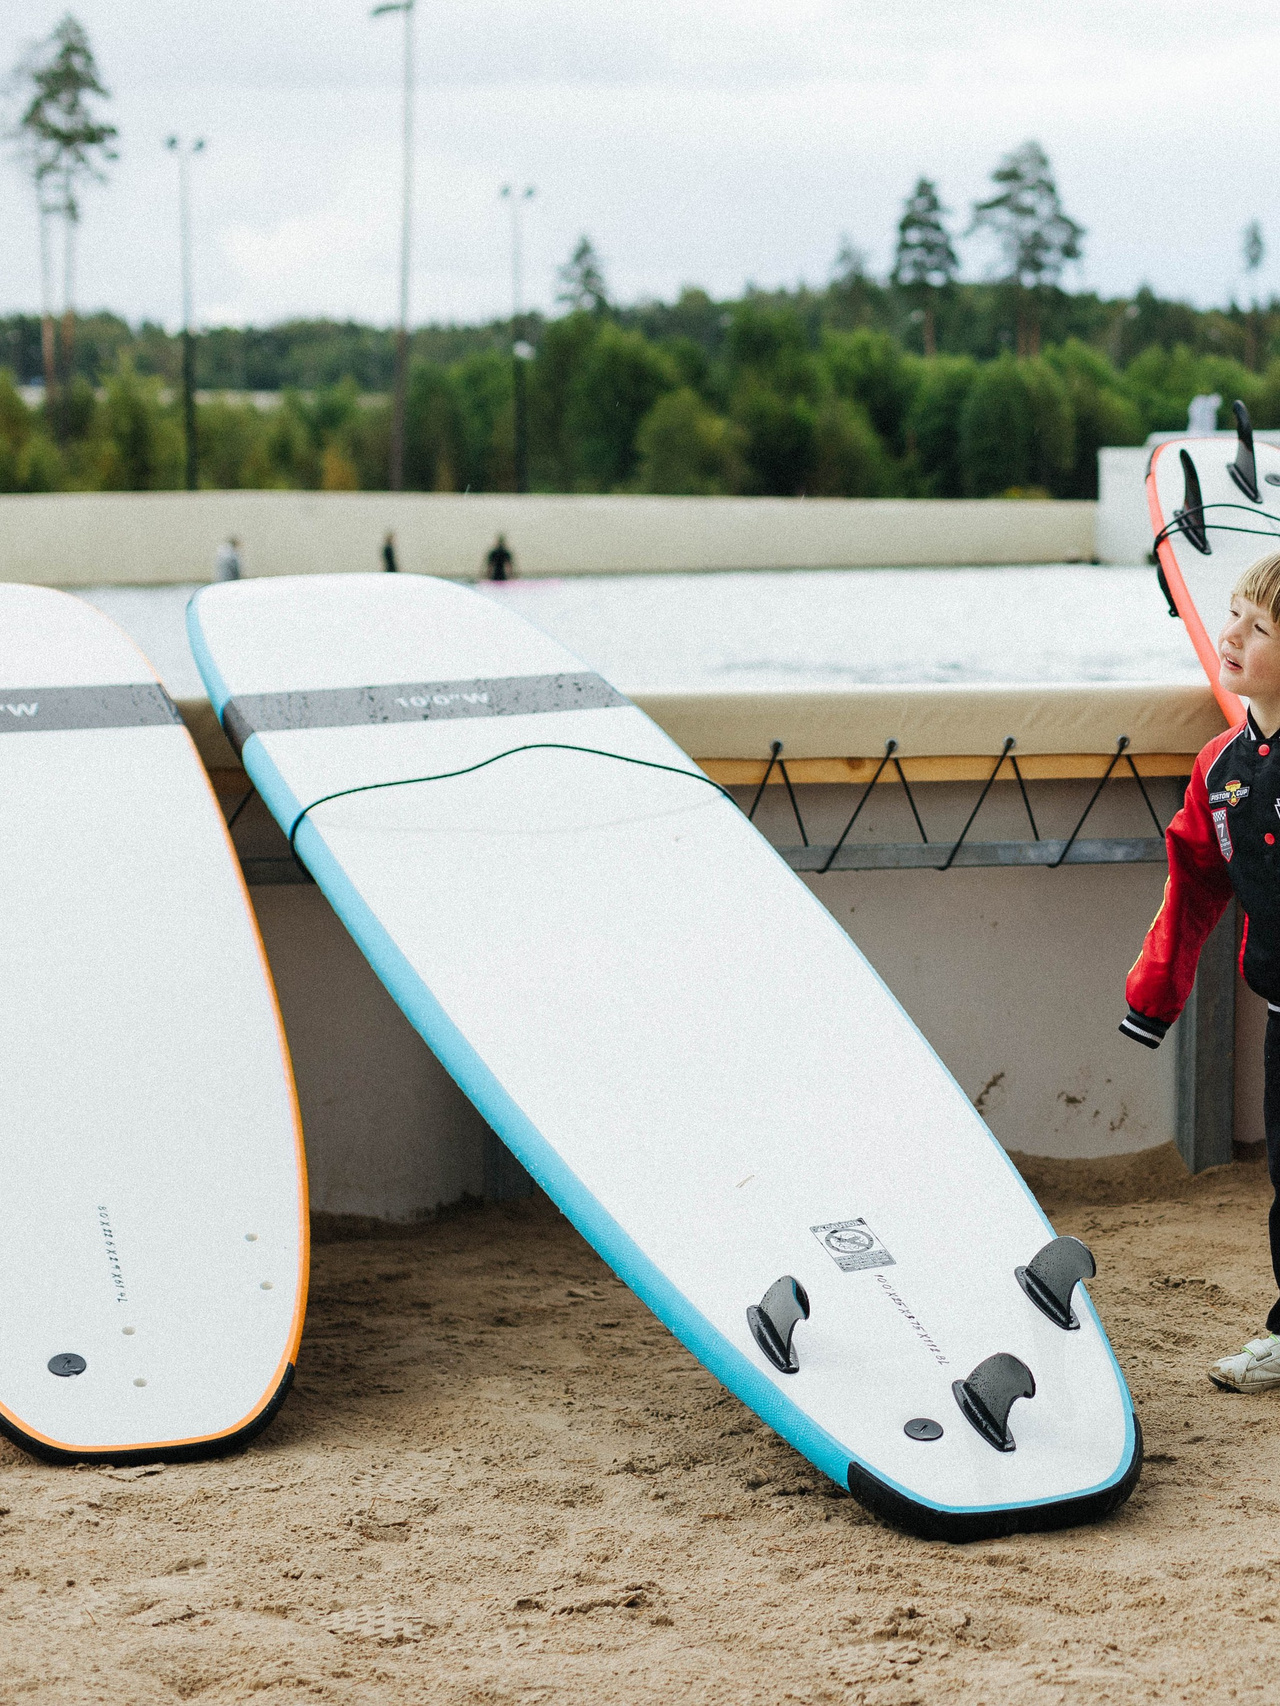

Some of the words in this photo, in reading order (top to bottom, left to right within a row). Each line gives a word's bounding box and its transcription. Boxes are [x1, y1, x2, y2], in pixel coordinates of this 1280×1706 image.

[1210, 791, 1231, 802] PISTON
[1236, 788, 1248, 797] CUP
[1217, 823, 1225, 838] 7
